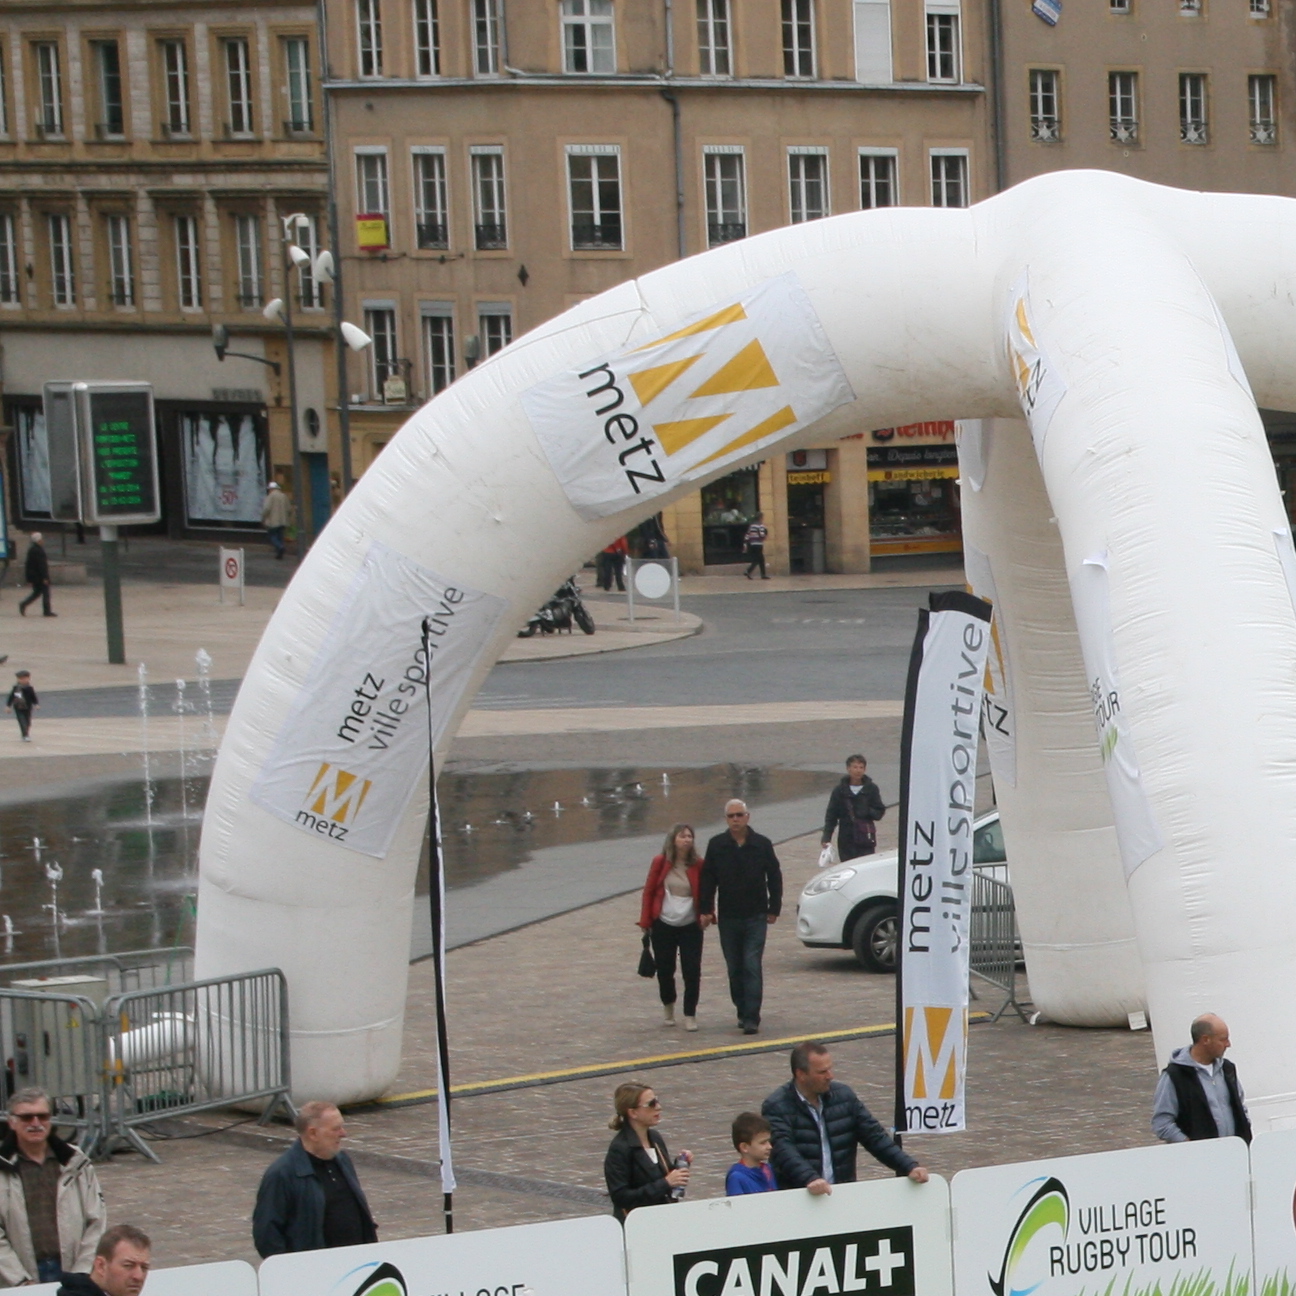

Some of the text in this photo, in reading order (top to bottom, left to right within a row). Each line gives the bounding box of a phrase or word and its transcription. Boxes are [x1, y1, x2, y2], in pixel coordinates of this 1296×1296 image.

[578, 362, 666, 495] metz
[337, 672, 385, 743] metz
[295, 810, 349, 842] metz
[909, 820, 935, 953] metz
[904, 1104, 957, 1132] metz
[1079, 1197, 1166, 1236] VILLAGE
[1050, 1228, 1197, 1278] RUGBY TOUR
